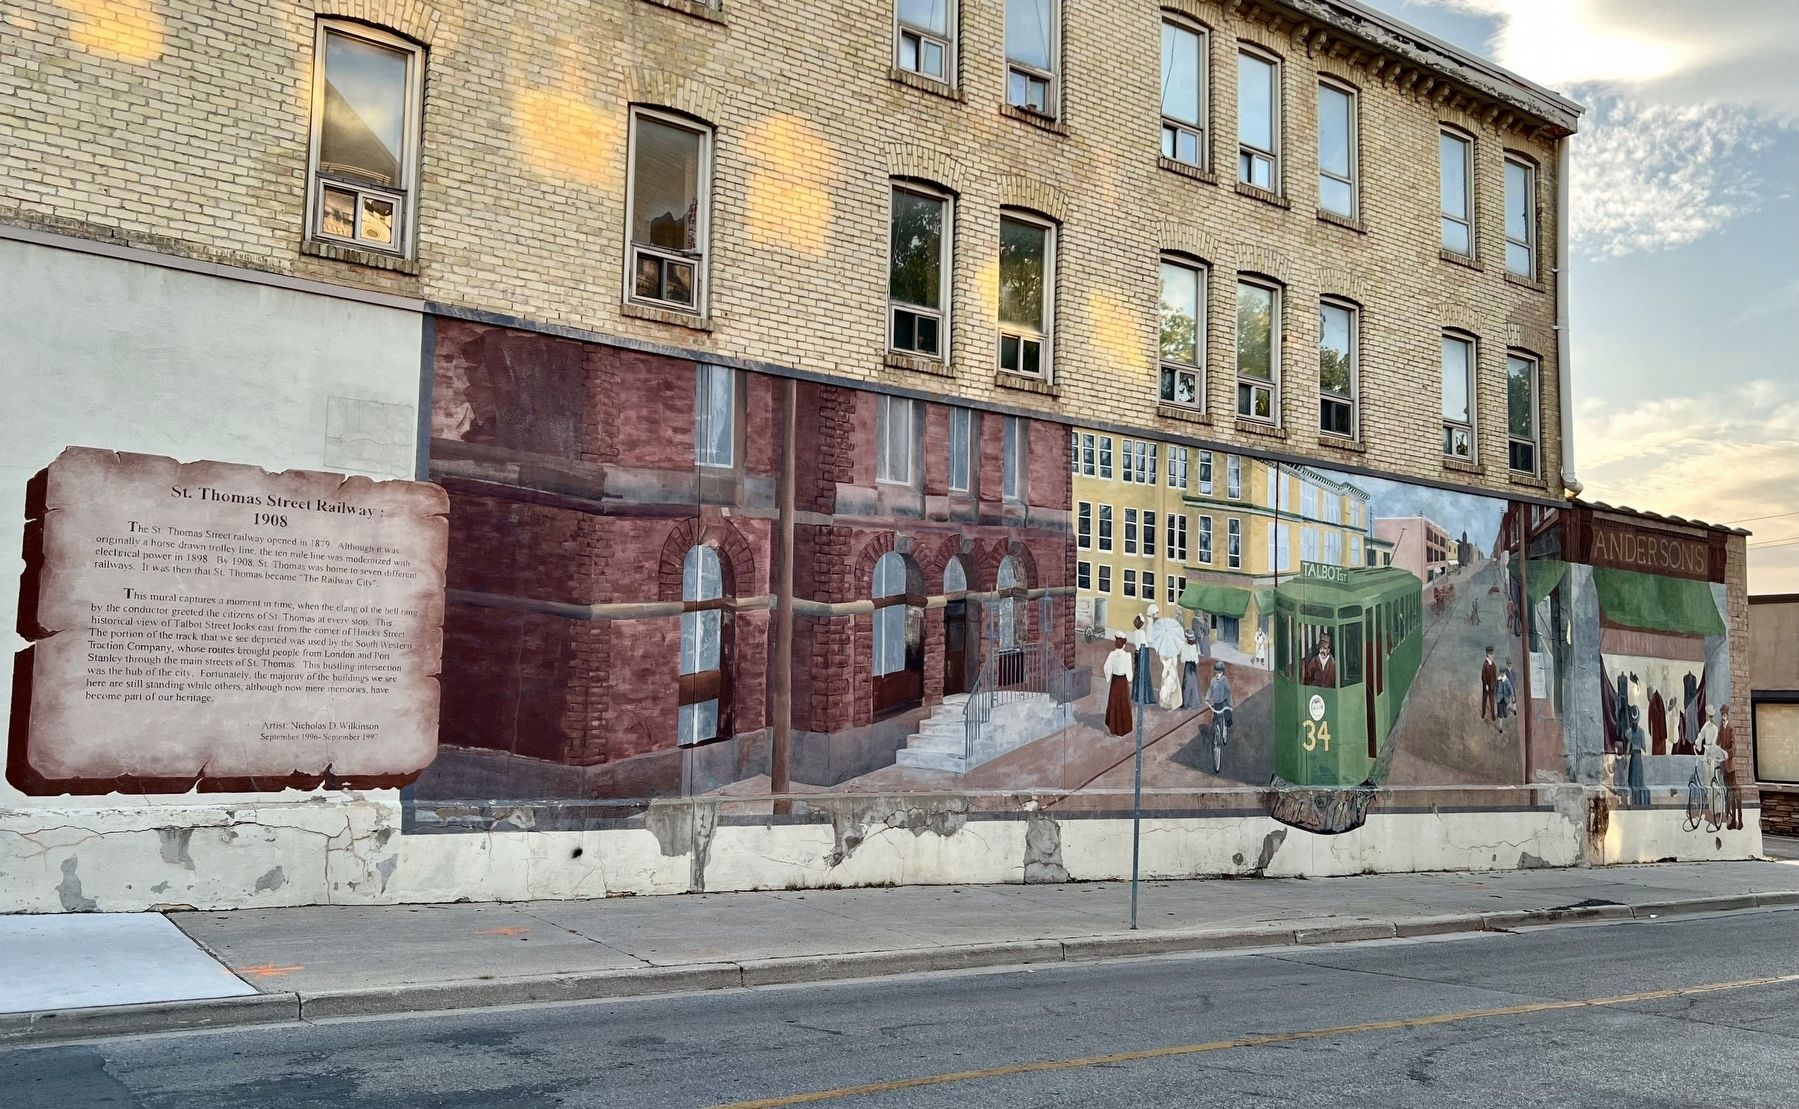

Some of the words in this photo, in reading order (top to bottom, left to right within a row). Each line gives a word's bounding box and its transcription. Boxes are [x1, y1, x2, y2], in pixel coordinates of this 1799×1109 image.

[171, 485, 192, 499] St.
[199, 486, 262, 505] Thomas
[267, 495, 311, 510] Street
[254, 513, 288, 527] 1908
[96, 537, 140, 546] originally
[151, 539, 175, 548] horse
[178, 541, 206, 550] drawn
[208, 545, 236, 555] trolley
[128, 521, 148, 533] The
[168, 527, 202, 538] Thomas
[206, 530, 230, 539] Street
[234, 533, 264, 544] railway
[338, 542, 374, 553] Although
[1593, 529, 1704, 572] ANDERSONS
[94, 560, 136, 571] railways.
[142, 563, 148, 571] It
[173, 566, 192, 574] then
[195, 567, 210, 576] that
[214, 568, 225, 577] St.
[229, 568, 262, 578] Thomas
[265, 572, 296, 581] became
[322, 576, 353, 585] Railway
[95, 548, 140, 558] electrical
[143, 552, 171, 561] power
[175, 552, 183, 560] in
[273, 561, 306, 571] Thomas
[326, 564, 348, 573] home
[384, 569, 417, 579] different
[1303, 561, 1342, 581] TALBOT
[124, 588, 147, 600] This
[150, 594, 176, 602] mural
[179, 594, 216, 604] captures
[226, 598, 260, 607] moment
[274, 601, 295, 610] time,
[336, 605, 358, 614] clang
[90, 603, 102, 612] by
[107, 604, 120, 612] the
[123, 605, 168, 614] conductor
[172, 608, 204, 617] greeted
[207, 609, 220, 617] the
[223, 610, 254, 620] citizens
[283, 613, 315, 622] Thomas
[328, 617, 349, 625] every
[376, 618, 392, 627] This
[91, 616, 133, 625] historical
[136, 618, 157, 626] view
[161, 619, 171, 627] of
[174, 619, 202, 628] Talbot
[233, 622, 255, 631] looks
[277, 624, 297, 633] from
[300, 626, 312, 634] the
[88, 640, 124, 650] Traction
[208, 645, 234, 654] routes
[238, 646, 270, 657] brought
[303, 649, 321, 657] from
[325, 650, 354, 659] London
[89, 628, 107, 637] The
[111, 630, 143, 639] portion
[147, 630, 157, 638] of
[160, 631, 173, 639] the
[176, 632, 197, 640] track
[201, 633, 217, 641] that
[252, 636, 286, 646] depicted
[308, 638, 326, 646] used
[329, 639, 338, 647] by
[356, 640, 378, 648] South
[381, 642, 412, 650] Western
[88, 653, 122, 664] Stanley
[125, 655, 161, 665] through
[205, 658, 233, 666] streets
[236, 658, 245, 666] of
[303, 660, 320, 668] This
[323, 661, 354, 672] bustling
[358, 663, 401, 672] intersection
[109, 666, 122, 675] the
[125, 666, 142, 675] hub
[146, 667, 156, 676] of
[158, 668, 172, 676] the
[270, 672, 303, 681] majority
[320, 673, 329, 681] the
[332, 674, 369, 683] buildings
[86, 678, 107, 687] here
[126, 679, 143, 688] still
[146, 680, 184, 690] standing
[246, 684, 282, 693] although
[86, 692, 122, 700] become
[125, 693, 142, 702] part
[1303, 720, 1331, 751] 34
